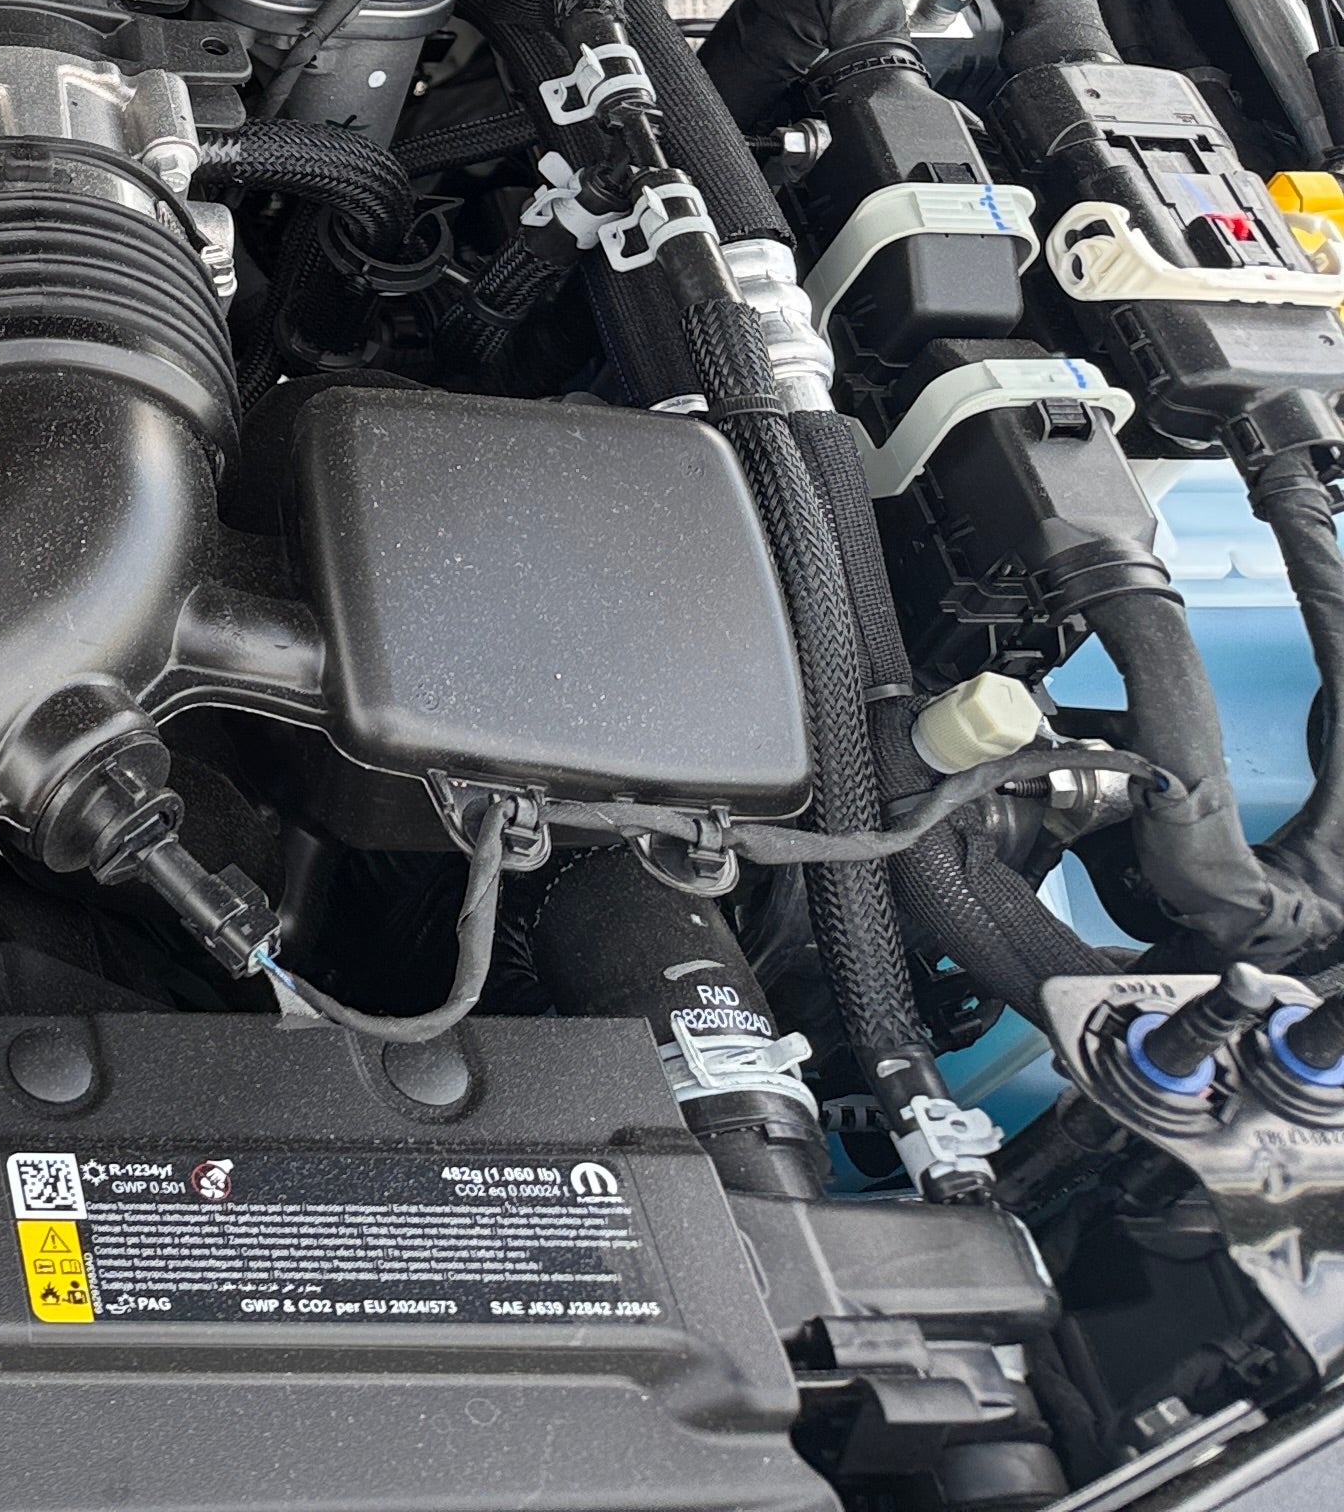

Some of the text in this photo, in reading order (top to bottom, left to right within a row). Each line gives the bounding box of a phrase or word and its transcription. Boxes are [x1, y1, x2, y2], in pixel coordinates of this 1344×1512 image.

[696, 985, 740, 1006] RAD
[109, 1163, 562, 1185] R-1234yf 482g (1.060 lb)
[112, 1181, 147, 1194] GWP
[149, 1181, 186, 1195] 0.501
[455, 1183, 487, 1197] CO2
[488, 1185, 507, 1200] eq
[136, 1297, 662, 1317] PAG GWP & CO2 per EU 2024/573 SAE J639 J2842 J2845
